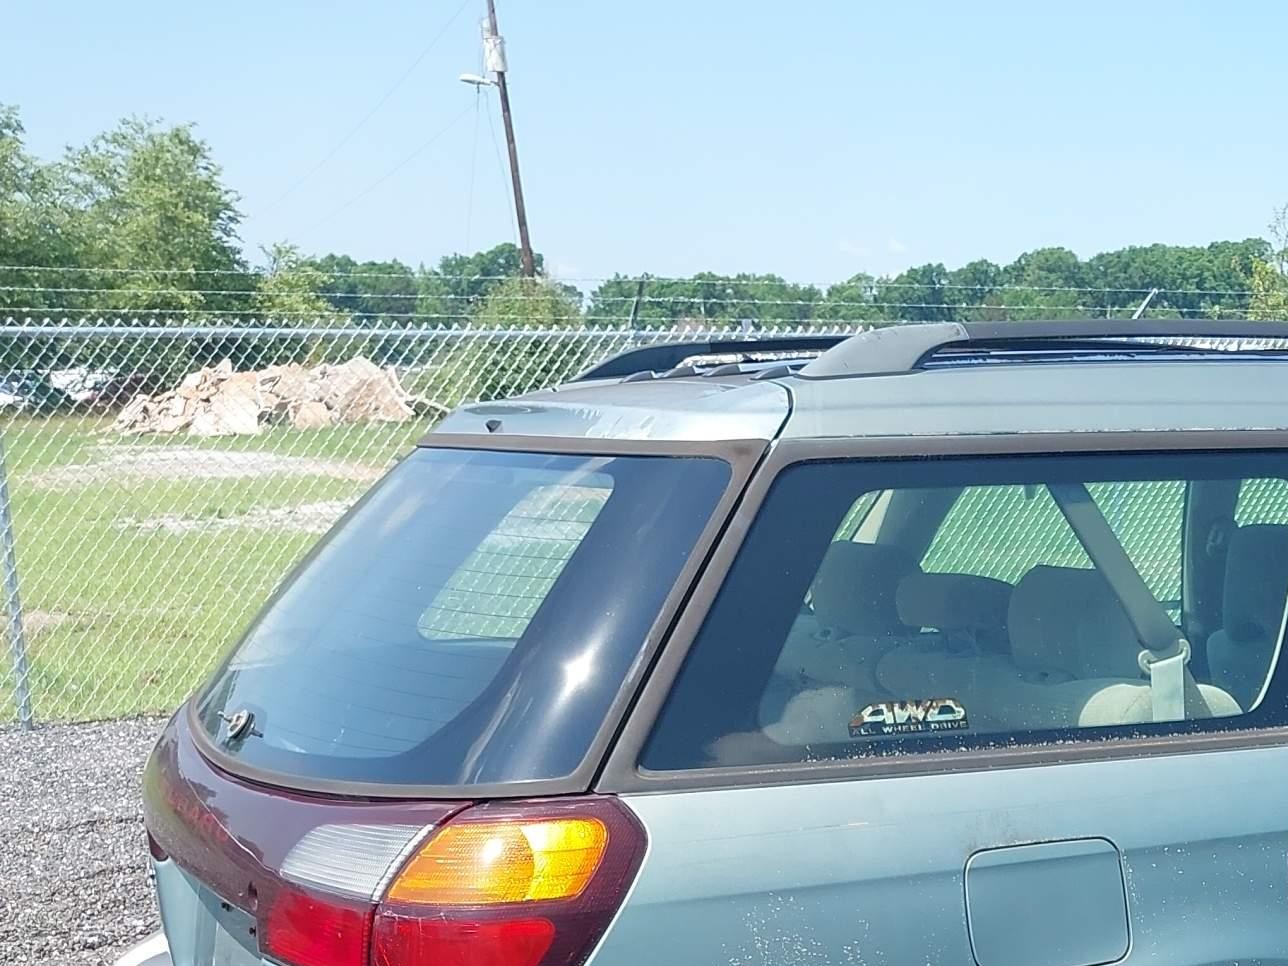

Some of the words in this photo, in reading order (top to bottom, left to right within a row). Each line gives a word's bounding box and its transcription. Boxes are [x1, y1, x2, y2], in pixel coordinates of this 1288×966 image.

[853, 699, 966, 725] AWD
[852, 726, 876, 735] ALL
[882, 724, 923, 734] WHEEL
[931, 720, 967, 730] DRIVE
